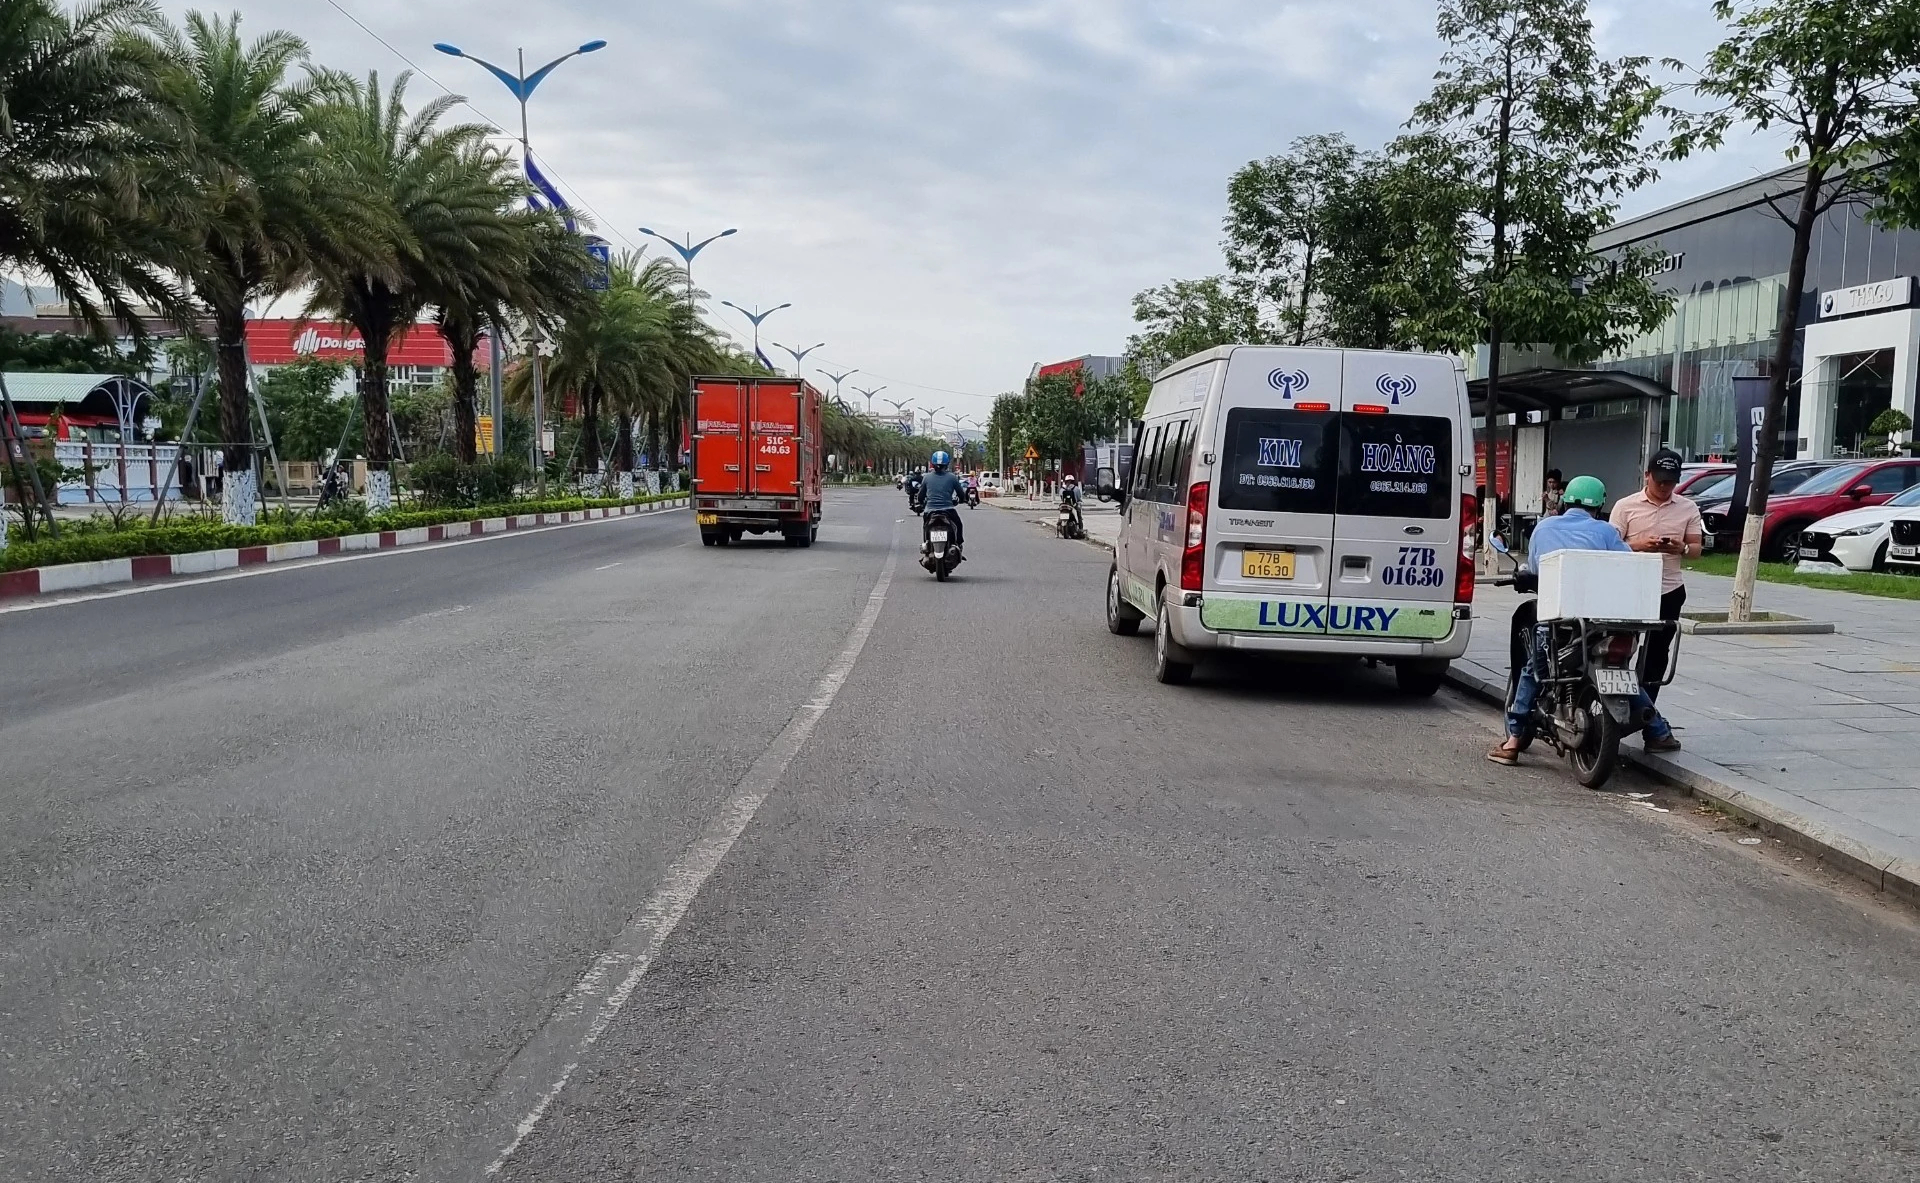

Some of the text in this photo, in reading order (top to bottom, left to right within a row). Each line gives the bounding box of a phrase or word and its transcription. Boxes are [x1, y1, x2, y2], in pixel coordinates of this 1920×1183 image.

[1849, 283, 1894, 307] THACO
[759, 445, 791, 454] 449.63
[1257, 437, 1303, 468] KIM
[1361, 433, 1436, 474] HOÀNG
[1228, 517, 1275, 528] TRANSIT
[1258, 552, 1280, 564] 77B
[1398, 546, 1436, 567] 77B
[1248, 564, 1289, 577] 016.30
[1382, 566, 1444, 588] 016.30
[1258, 601, 1400, 632] LUXURY
[1602, 670, 1632, 682] 77-L1
[1600, 681, 1638, 694] 574.26
